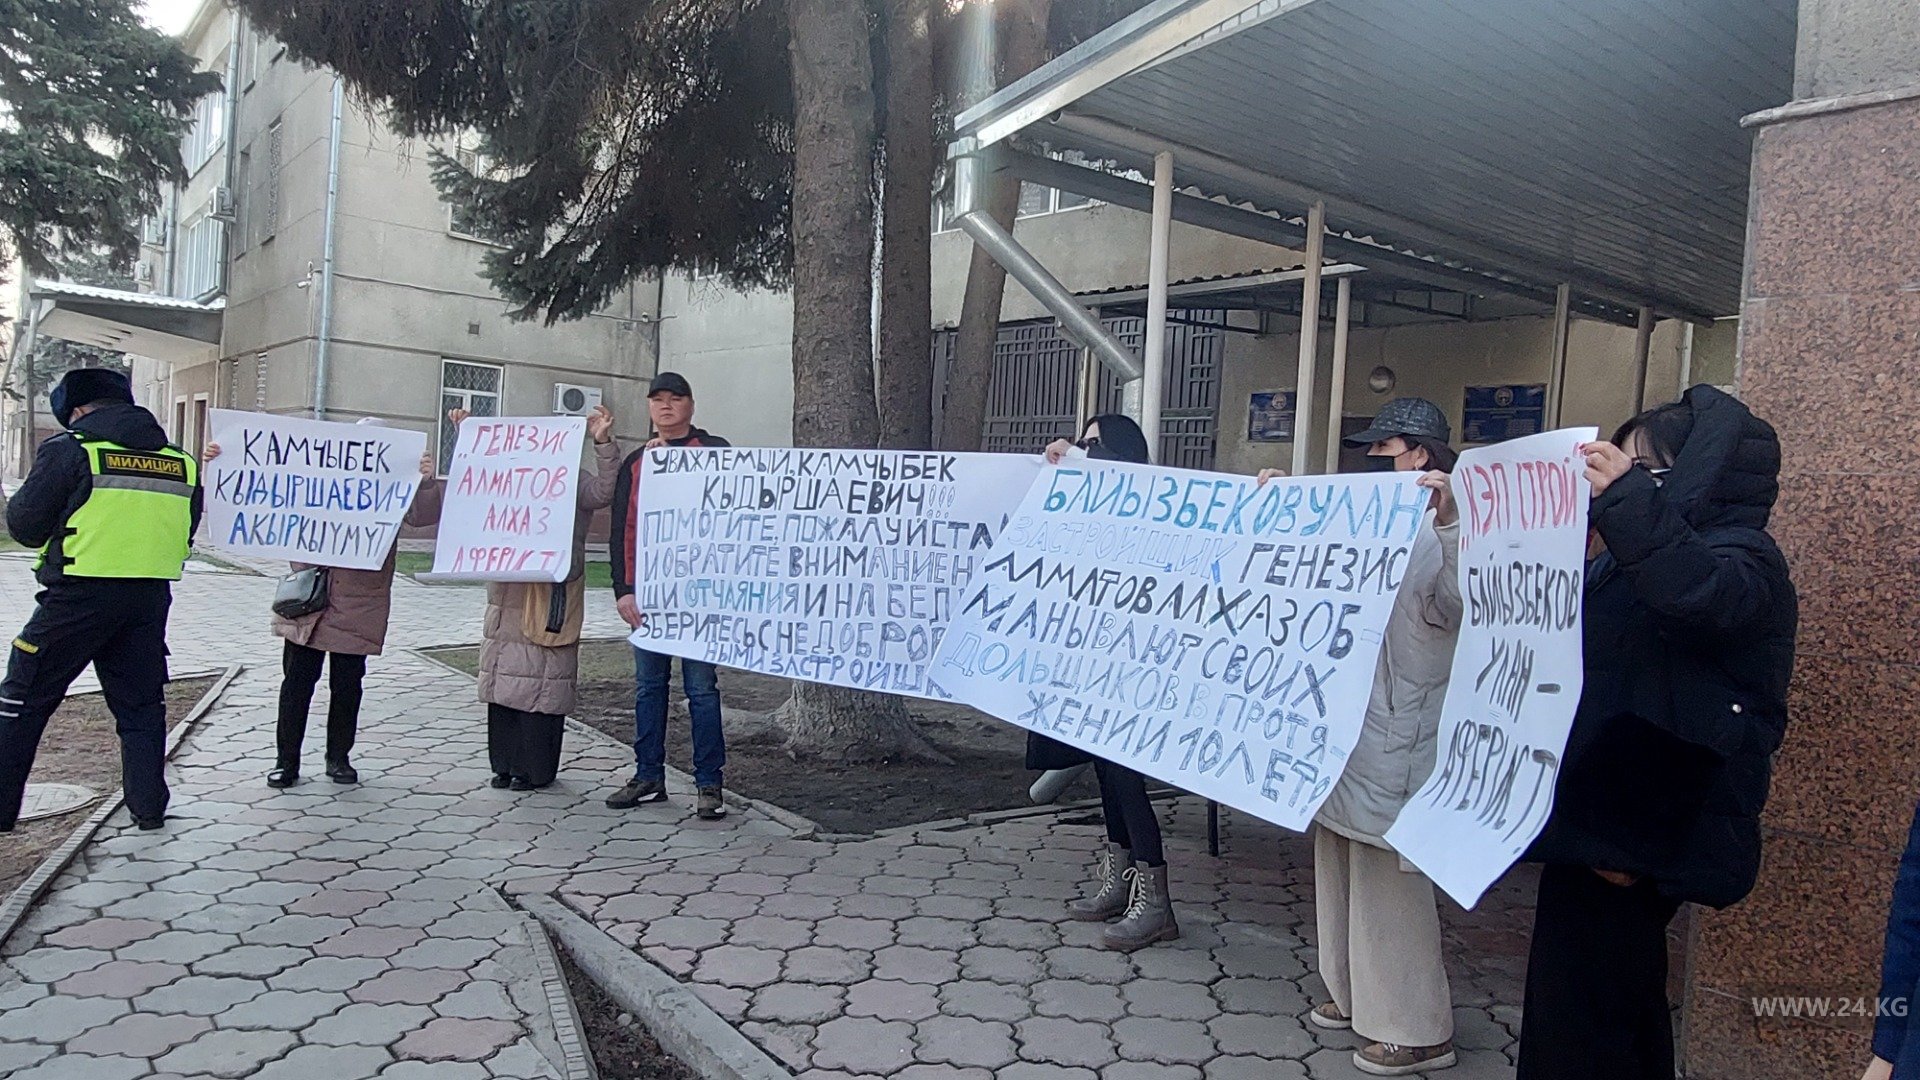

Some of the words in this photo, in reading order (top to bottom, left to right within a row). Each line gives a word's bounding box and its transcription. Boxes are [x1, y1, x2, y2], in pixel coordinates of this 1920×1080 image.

[107, 455, 182, 474] МИЛИЦИЯ
[243, 428, 391, 474] КАМЧЫБЕК
[214, 468, 412, 513] КЫДЫРШАЕВИЧ
[457, 465, 568, 500] АЛМАТОВ
[483, 502, 551, 536] АЛХАЗ
[1238, 542, 1408, 596] ГЕНЕЗИС
[1200, 636, 1337, 719] СВОИХ
[1017, 689, 1172, 764] ЖЕНИИ
